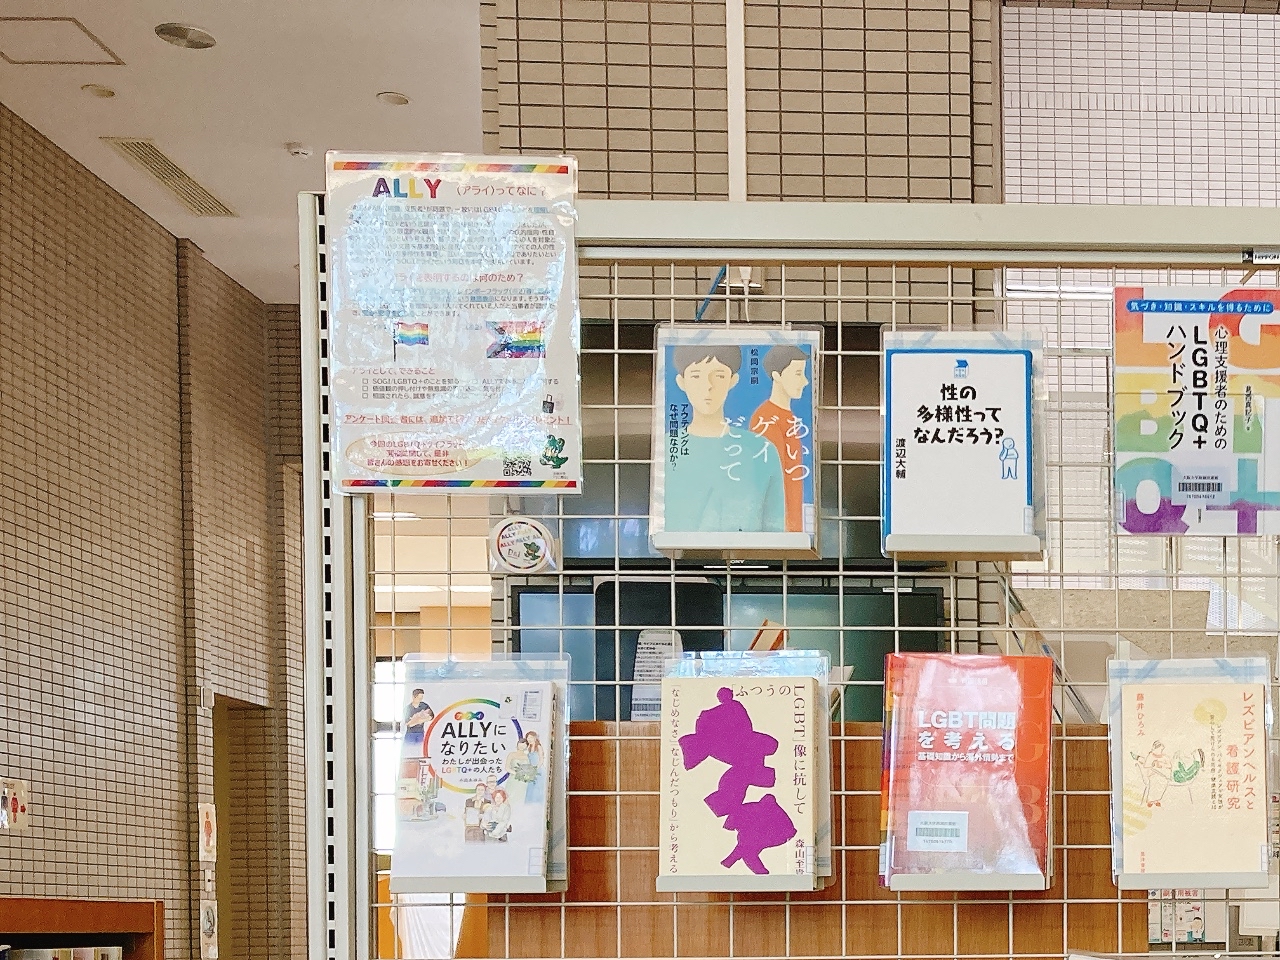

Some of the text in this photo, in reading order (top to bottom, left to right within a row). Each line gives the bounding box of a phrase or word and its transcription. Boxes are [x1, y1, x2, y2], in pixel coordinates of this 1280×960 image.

[372, 177, 442, 199] ALLY
[940, 383, 977, 401] 性の
[1166, 325, 1188, 449] ハンドブック
[1191, 325, 1209, 449] LGBTQ+
[1214, 325, 1228, 449] 心理支援者のための
[680, 403, 690, 456] アウティングは
[751, 415, 779, 463] ゲイ
[916, 405, 1002, 423] 多様性って
[719, 416, 746, 481] だって
[785, 415, 810, 481] あいつ
[441, 722, 506, 738] ALLYに
[918, 710, 1016, 729] LGBT問題
[918, 730, 1015, 750] を考える
[441, 741, 506, 755] なりたい
[1243, 692, 1256, 809] レズビアンヘルスと
[1226, 745, 1240, 809] 看護研究
